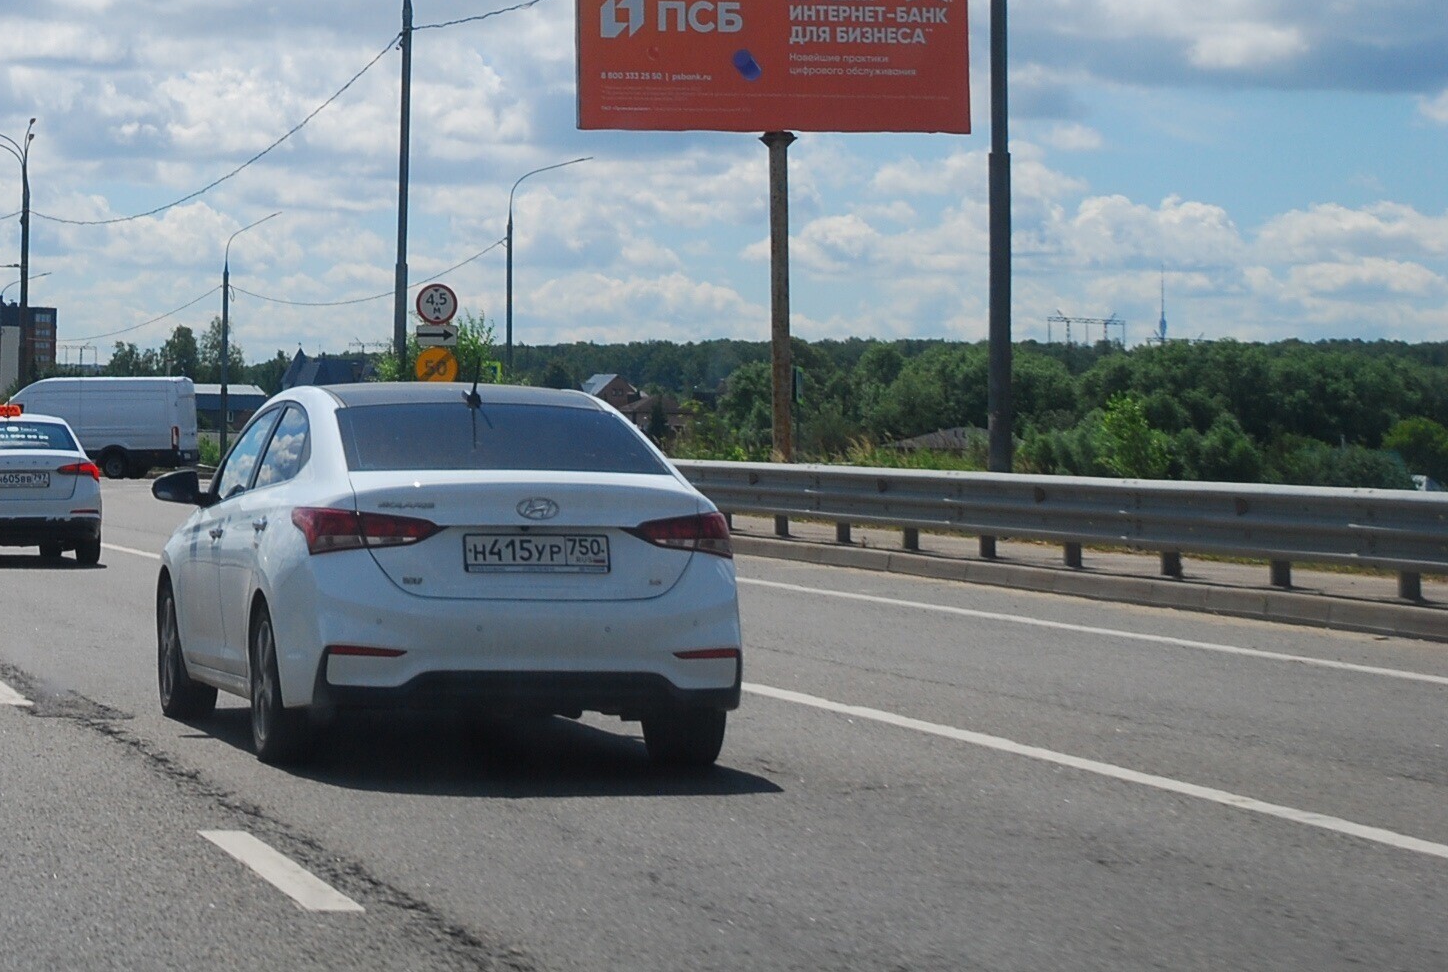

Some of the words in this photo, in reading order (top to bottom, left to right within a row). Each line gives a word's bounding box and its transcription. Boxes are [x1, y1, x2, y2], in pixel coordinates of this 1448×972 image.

[657, 0, 743, 33] ПСБ
[788, 5, 948, 24] ИНТЕРНЕТ-БАНК
[788, 26, 831, 46] ДЛЯ
[789, 52, 841, 63] Новейшие
[842, 55, 890, 64] практики
[789, 65, 844, 77] цифрового
[846, 65, 918, 78] обслуживания
[425, 359, 448, 377] 50
[473, 539, 562, 562] Н415УР
[567, 538, 601, 556] 750
